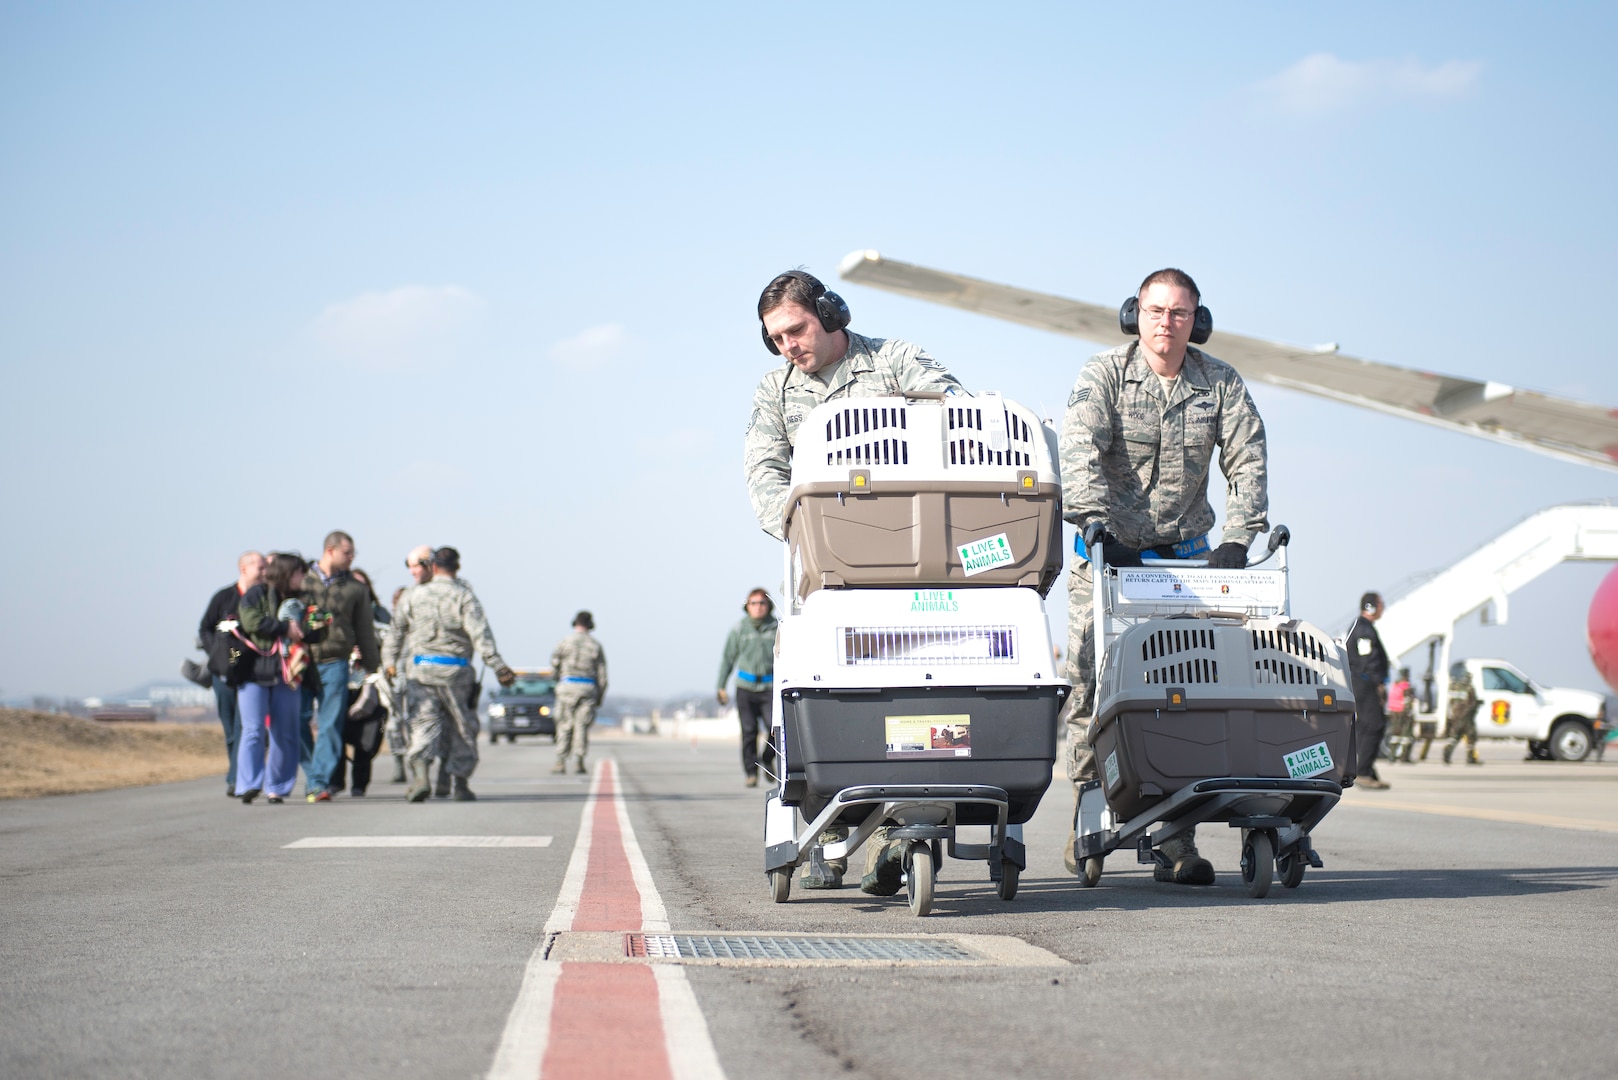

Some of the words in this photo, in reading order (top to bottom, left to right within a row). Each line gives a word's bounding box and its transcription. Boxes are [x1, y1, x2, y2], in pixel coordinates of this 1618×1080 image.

[786, 414, 803, 423] HESS
[971, 539, 996, 556] LIVE
[965, 548, 1011, 571] ANIMALS
[922, 591, 945, 601] LIVE
[911, 601, 959, 612] ANIMALS
[1295, 745, 1317, 764] LIVE
[1291, 756, 1331, 779] ANIMALS
